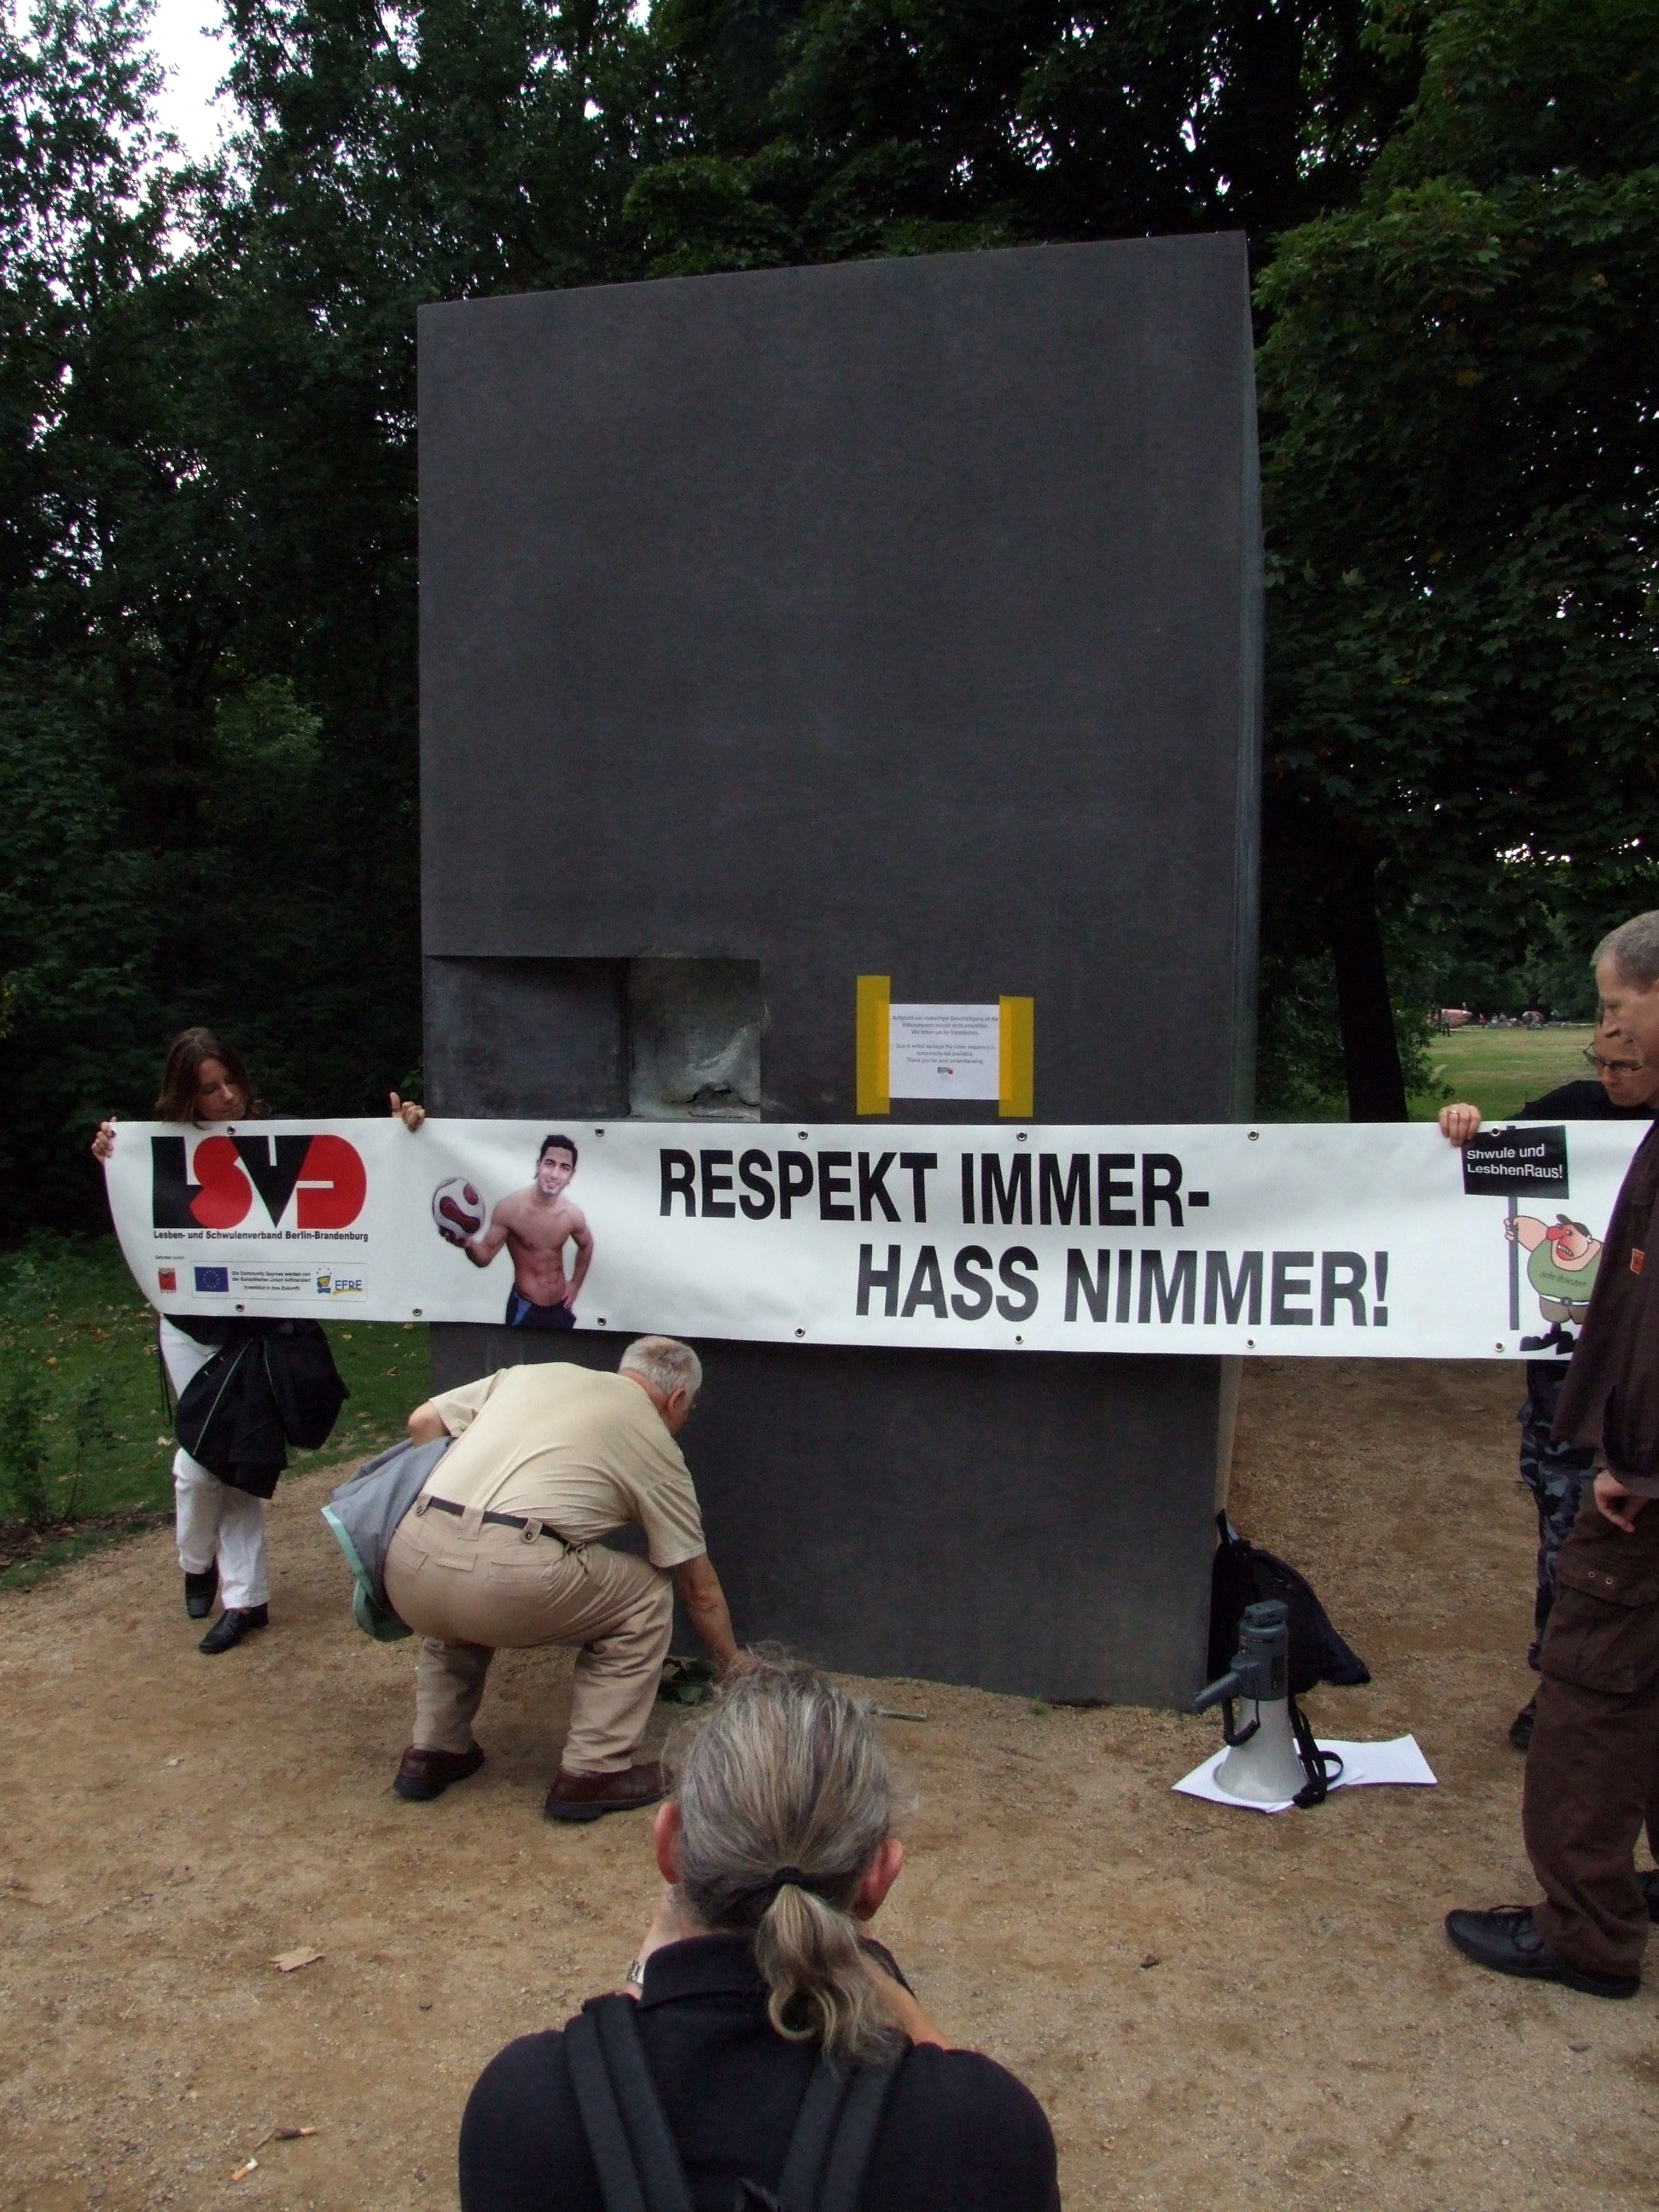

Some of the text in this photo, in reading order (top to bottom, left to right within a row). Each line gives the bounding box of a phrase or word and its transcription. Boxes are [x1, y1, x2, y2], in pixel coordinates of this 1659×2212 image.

[1466, 1143, 1545, 1160] Shwule und
[1467, 1164, 1563, 1179] LesbhenRaus!
[151, 1134, 368, 1230] LSVD
[659, 1148, 1210, 1227] RESPEKT IMMER-
[154, 1231, 369, 1243] Lesben- und Schwulenverband Berlin-Brandenburg
[335, 1279, 362, 1290] EFRE
[854, 1244, 1390, 1328] HASS NIMMER!
